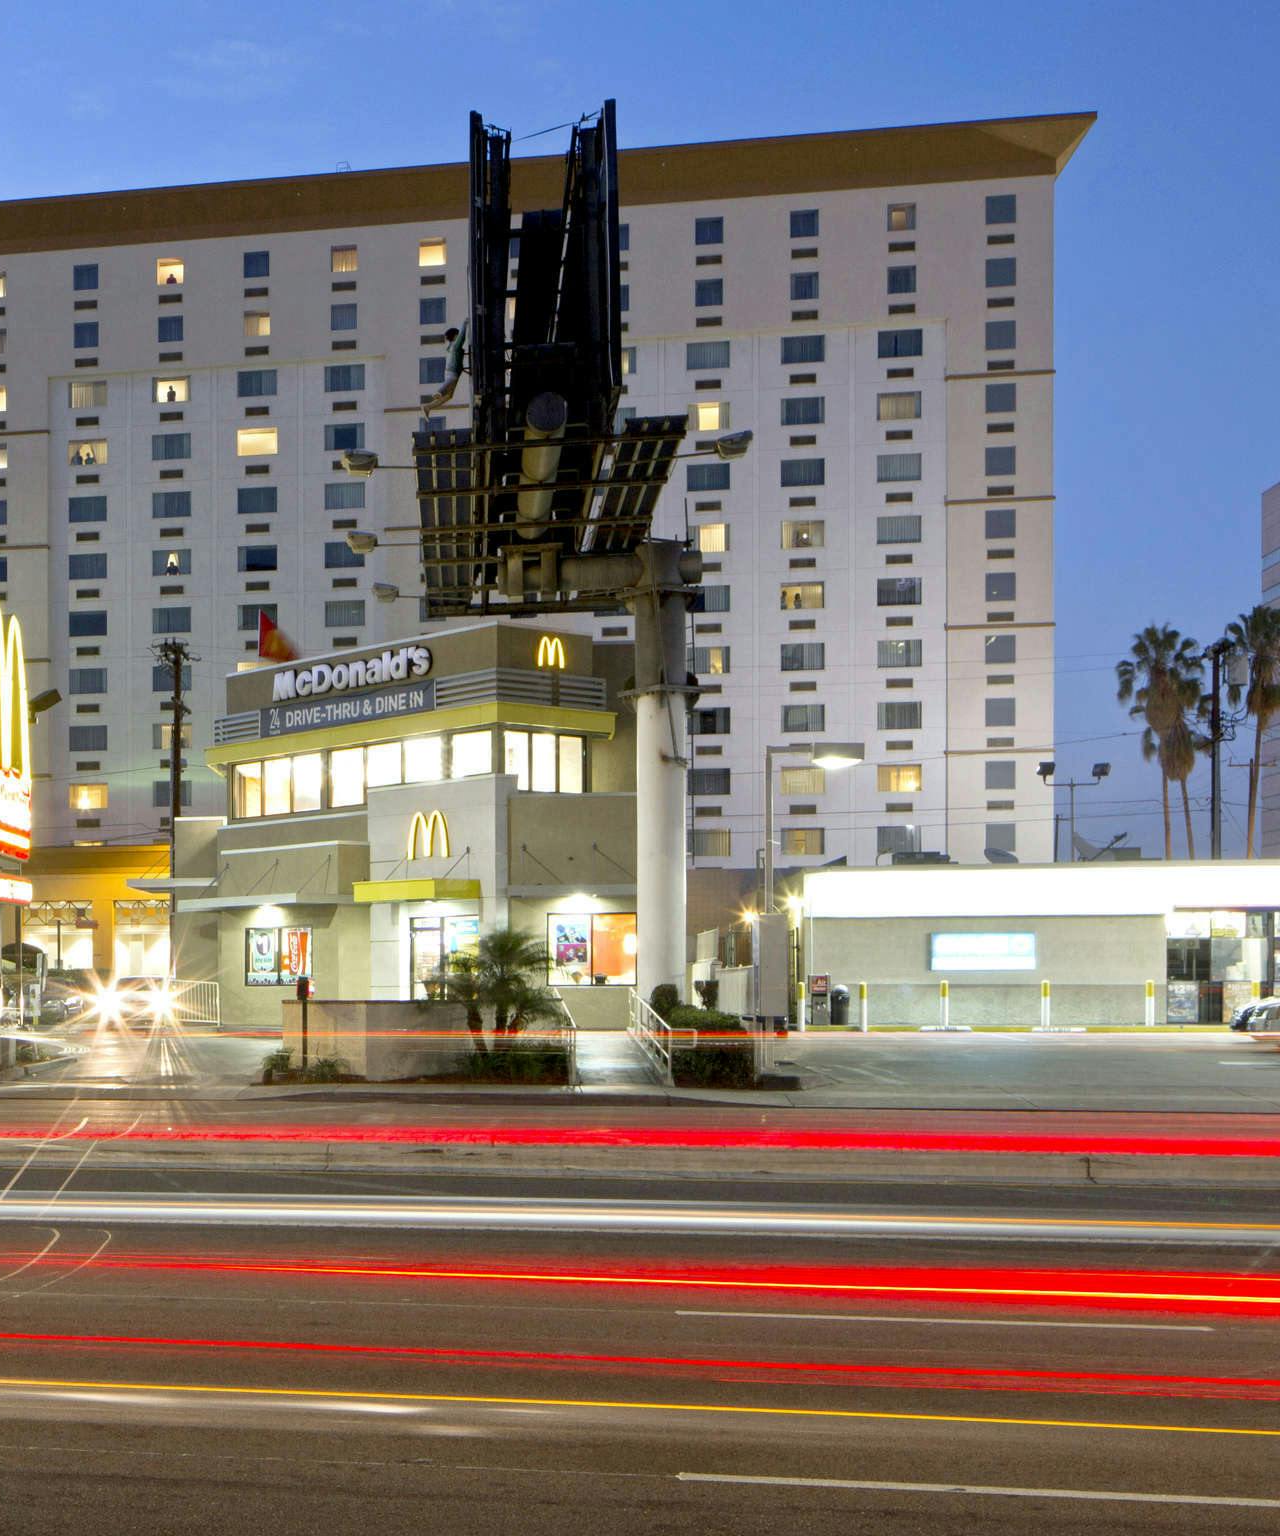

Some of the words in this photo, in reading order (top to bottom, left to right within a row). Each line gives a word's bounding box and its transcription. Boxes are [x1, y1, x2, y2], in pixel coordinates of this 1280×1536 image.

[272, 645, 432, 702] McDonald's
[269, 707, 281, 729] 24
[285, 700, 360, 728] DRIVE-THRU
[362, 698, 372, 716] &
[375, 693, 407, 714] DINE
[409, 689, 424, 709] IN
